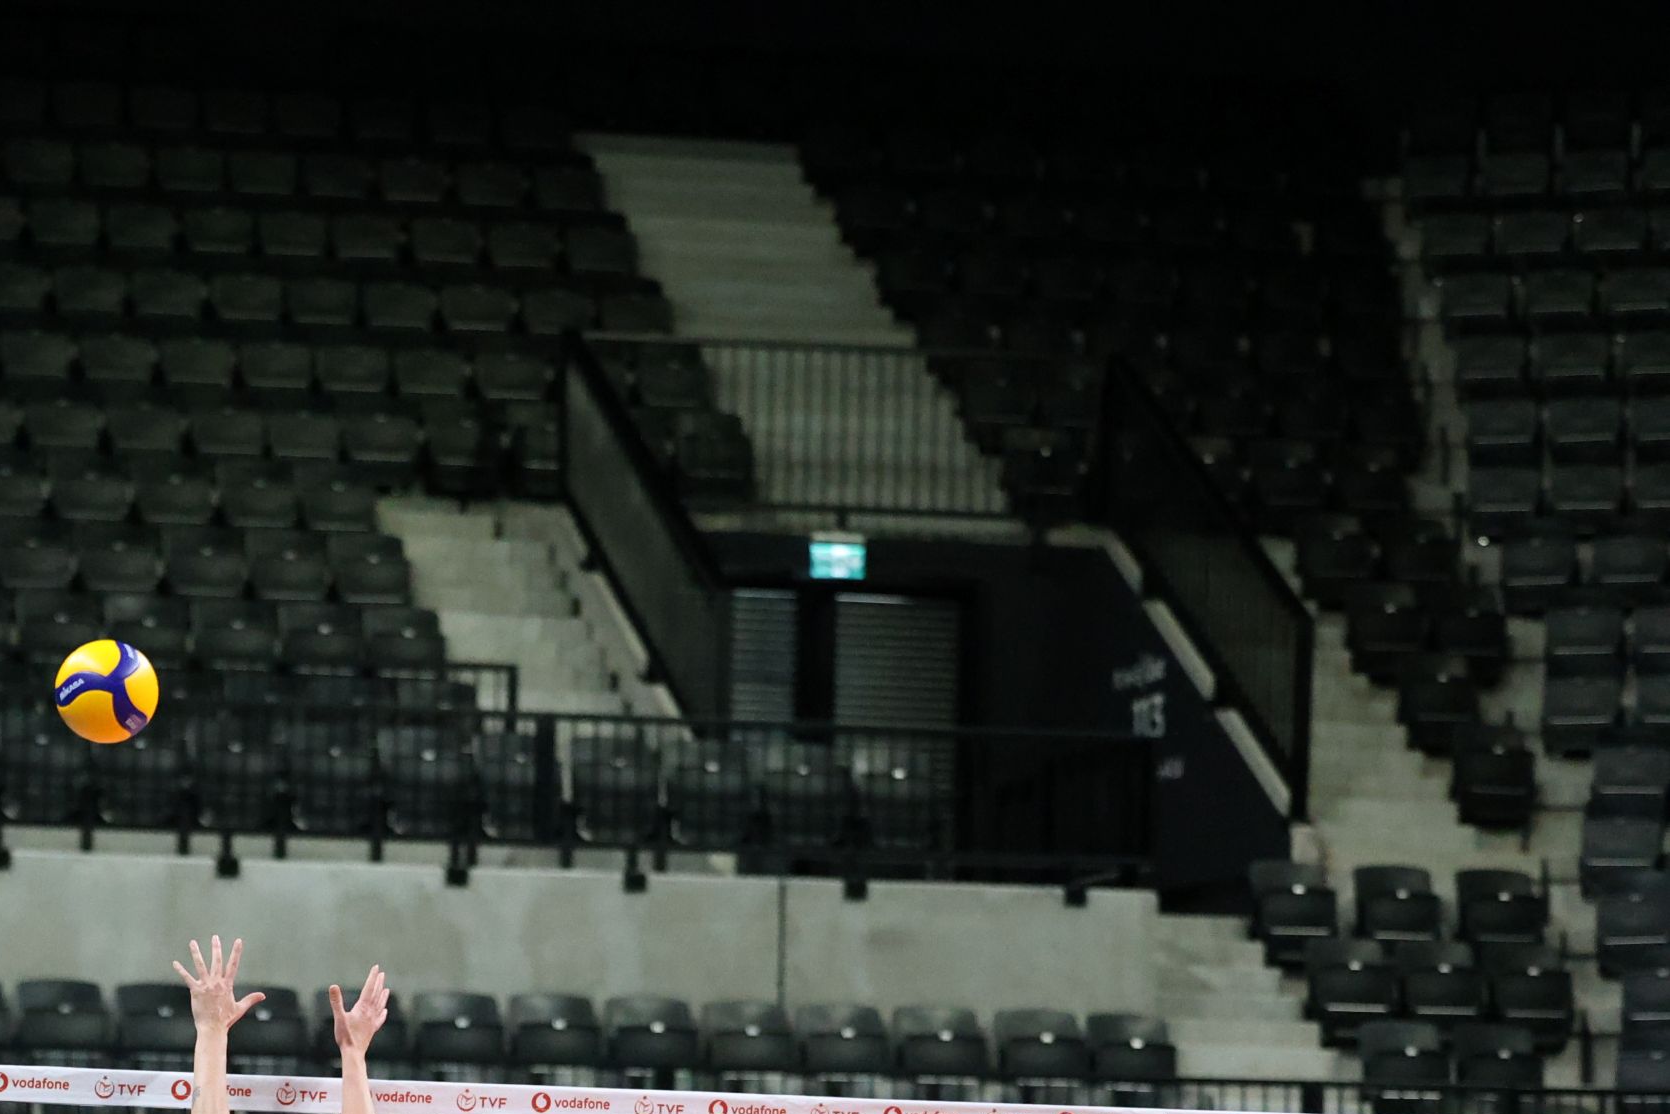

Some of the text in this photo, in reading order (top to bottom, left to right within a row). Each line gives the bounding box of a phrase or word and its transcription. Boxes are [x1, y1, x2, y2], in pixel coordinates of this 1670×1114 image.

[11, 1077, 69, 1091] vodafone
[118, 1084, 146, 1096] TVF
[299, 1091, 327, 1103] TVF
[376, 1091, 432, 1105] vodafone
[480, 1097, 508, 1109] TVF
[554, 1098, 610, 1111] vodafone
